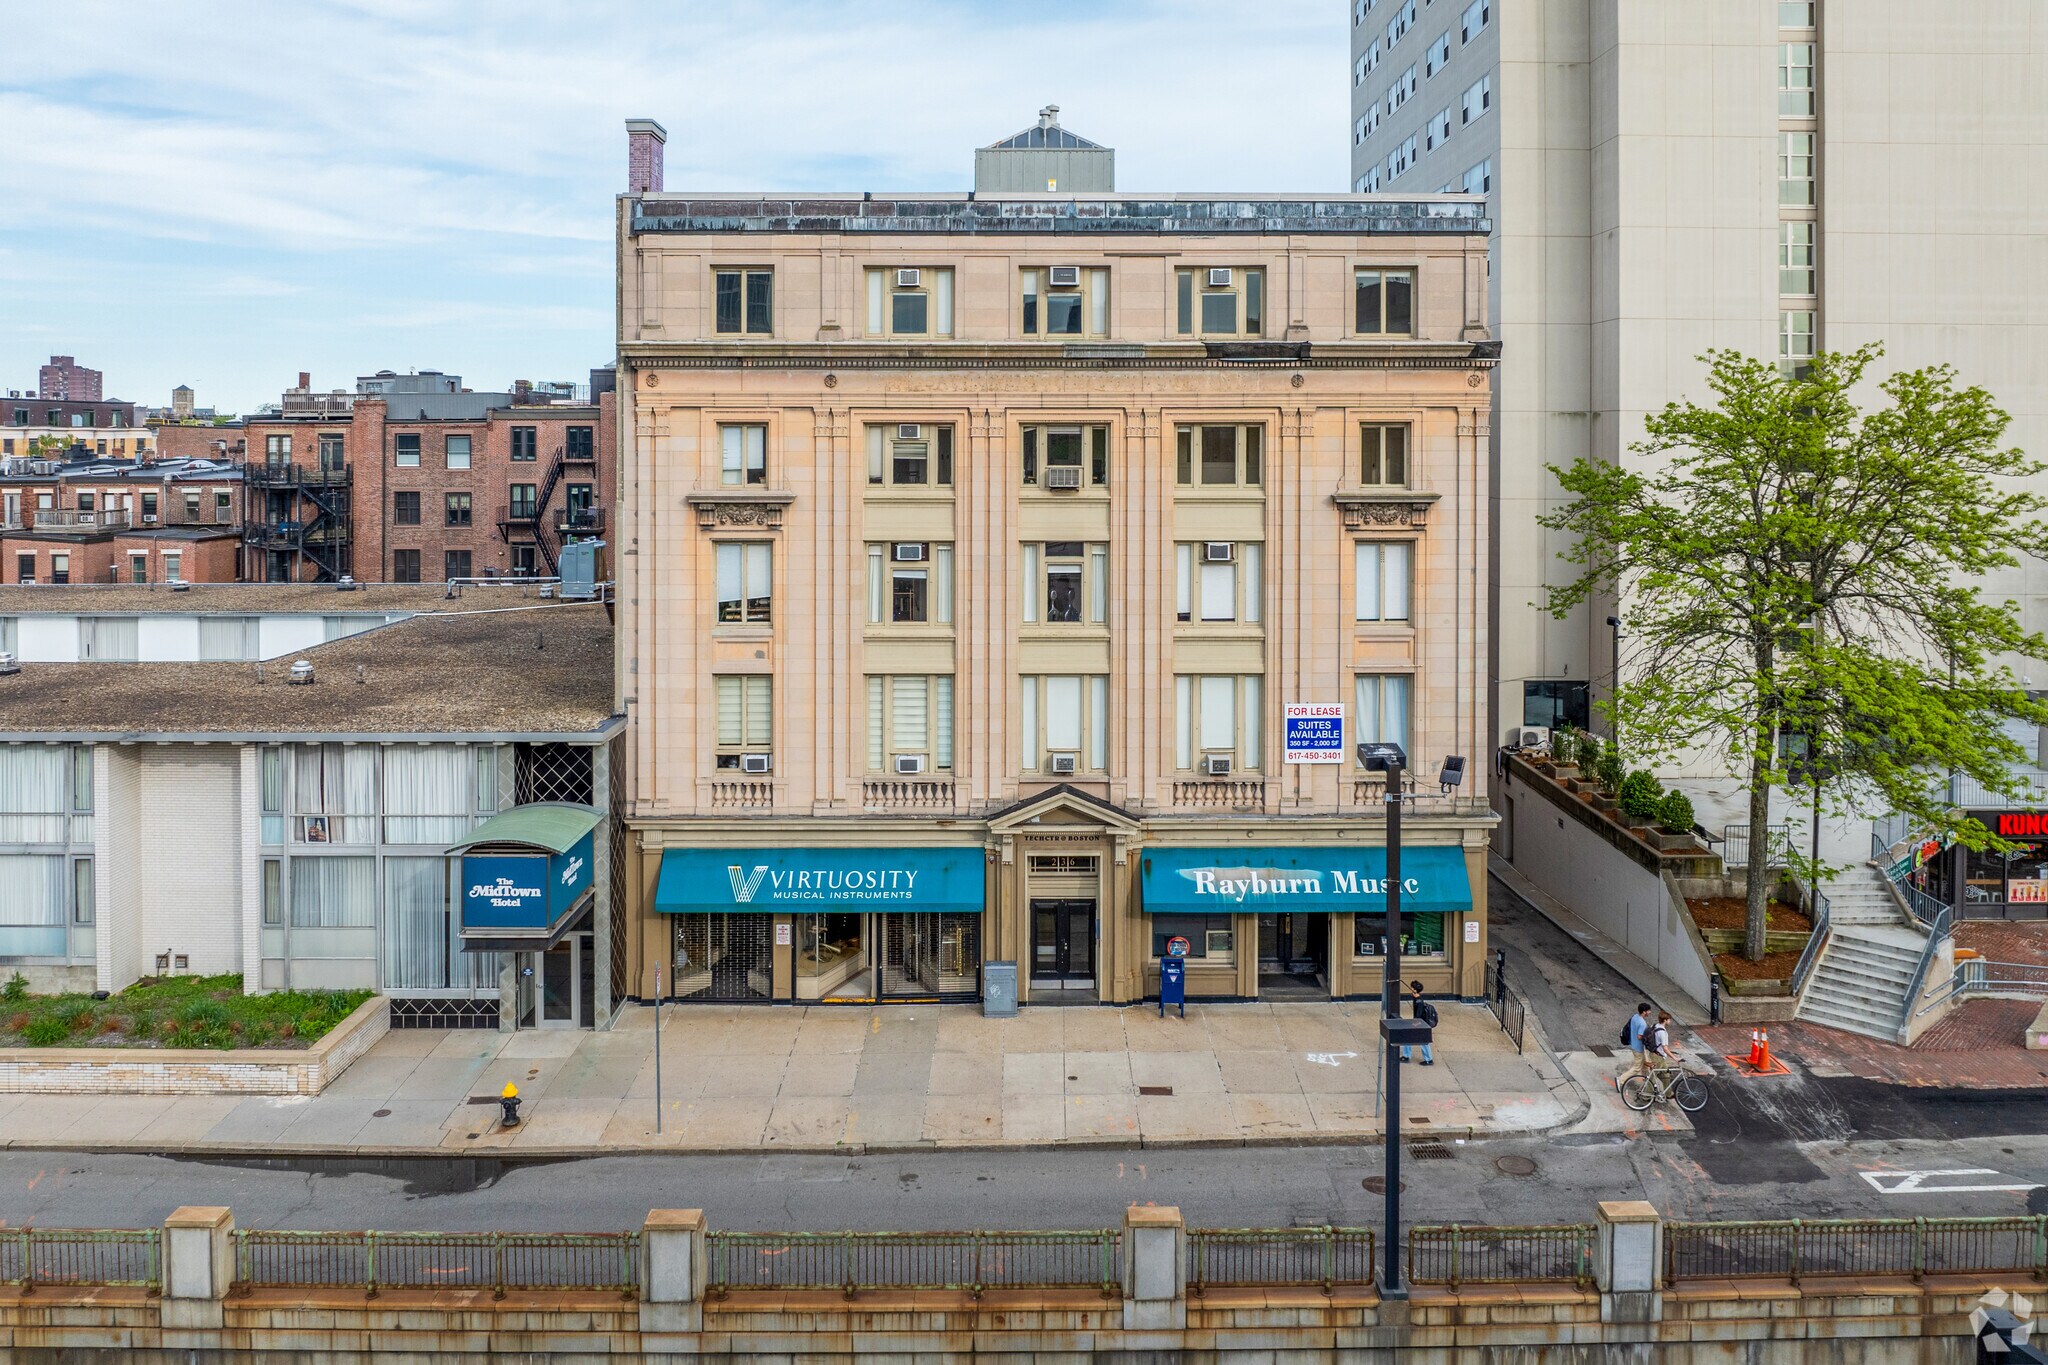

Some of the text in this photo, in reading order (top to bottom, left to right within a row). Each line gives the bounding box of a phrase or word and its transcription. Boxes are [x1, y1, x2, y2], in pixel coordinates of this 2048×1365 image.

[1288, 707, 1341, 716] FOR LEASE
[1298, 721, 1331, 729] SUITES
[1289, 731, 1340, 739] AVAILABLE
[1288, 752, 1341, 760] 617-450-3401
[496, 877, 514, 885] The
[770, 870, 918, 889] VIRTUOSITY
[1193, 870, 1419, 902] Rayburn Musc
[468, 885, 541, 898] MidTown
[773, 891, 913, 899] MUSICAL INSTRUMENTS
[490, 898, 521, 907] Hotel
